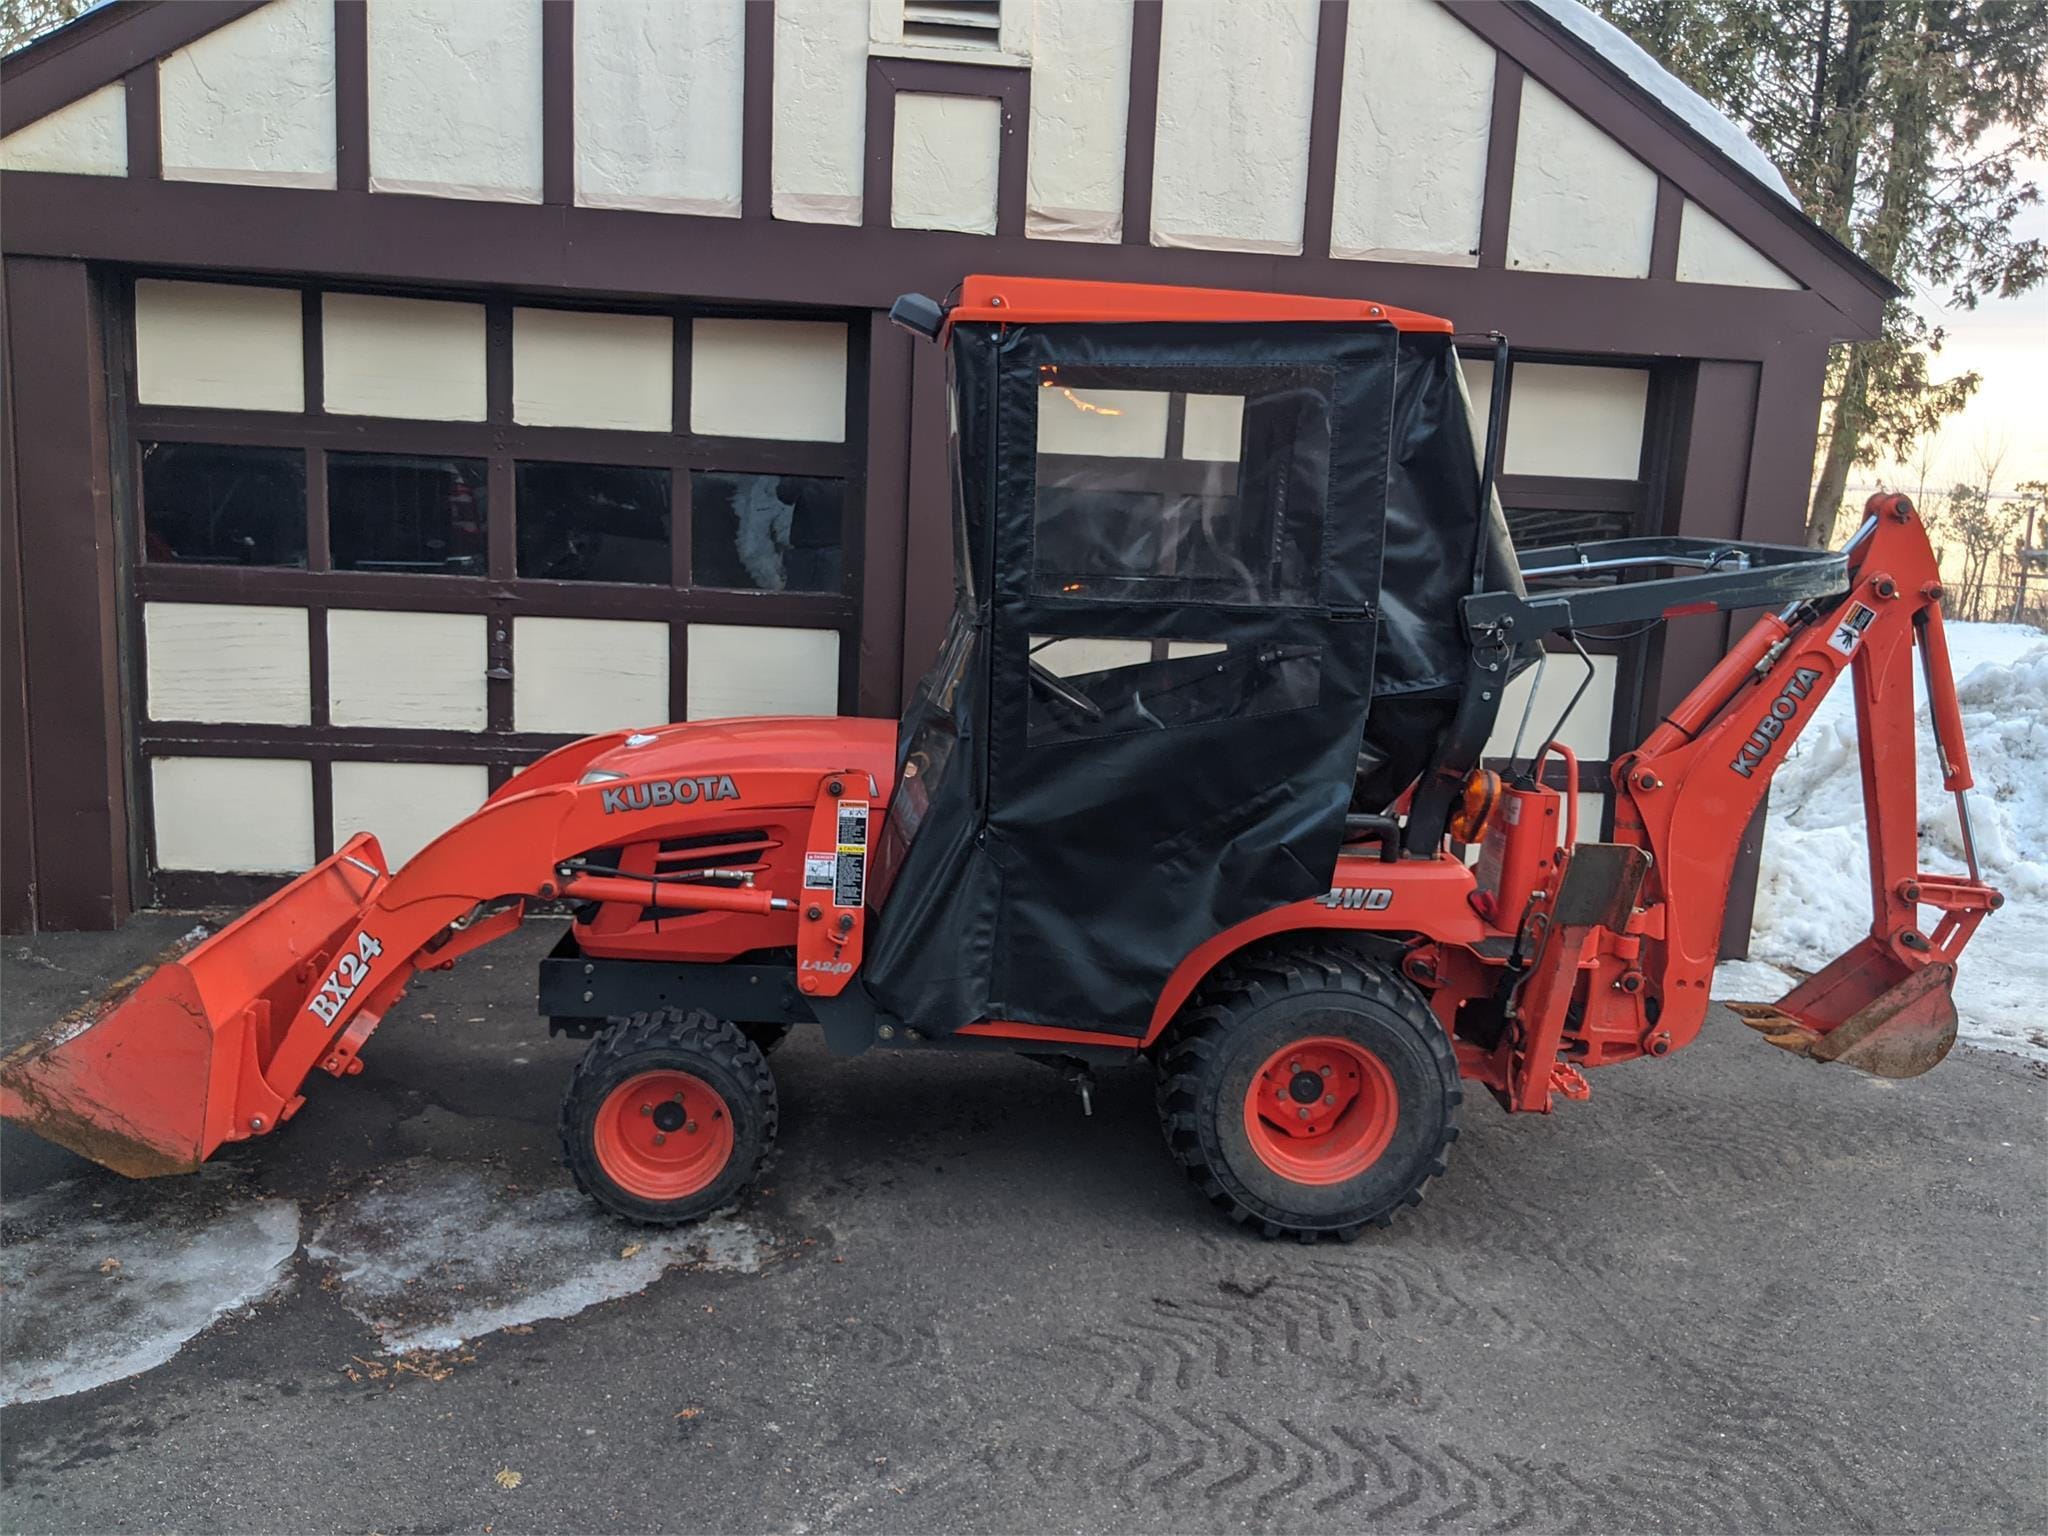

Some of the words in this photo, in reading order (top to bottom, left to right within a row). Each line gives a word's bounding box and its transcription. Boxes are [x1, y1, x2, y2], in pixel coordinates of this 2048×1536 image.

[1729, 667, 1823, 779] KUBOTA
[602, 774, 740, 815] KUBOTA
[1314, 887, 1393, 911] 4WD
[308, 930, 384, 1028] BX24
[800, 960, 852, 975] LA240
